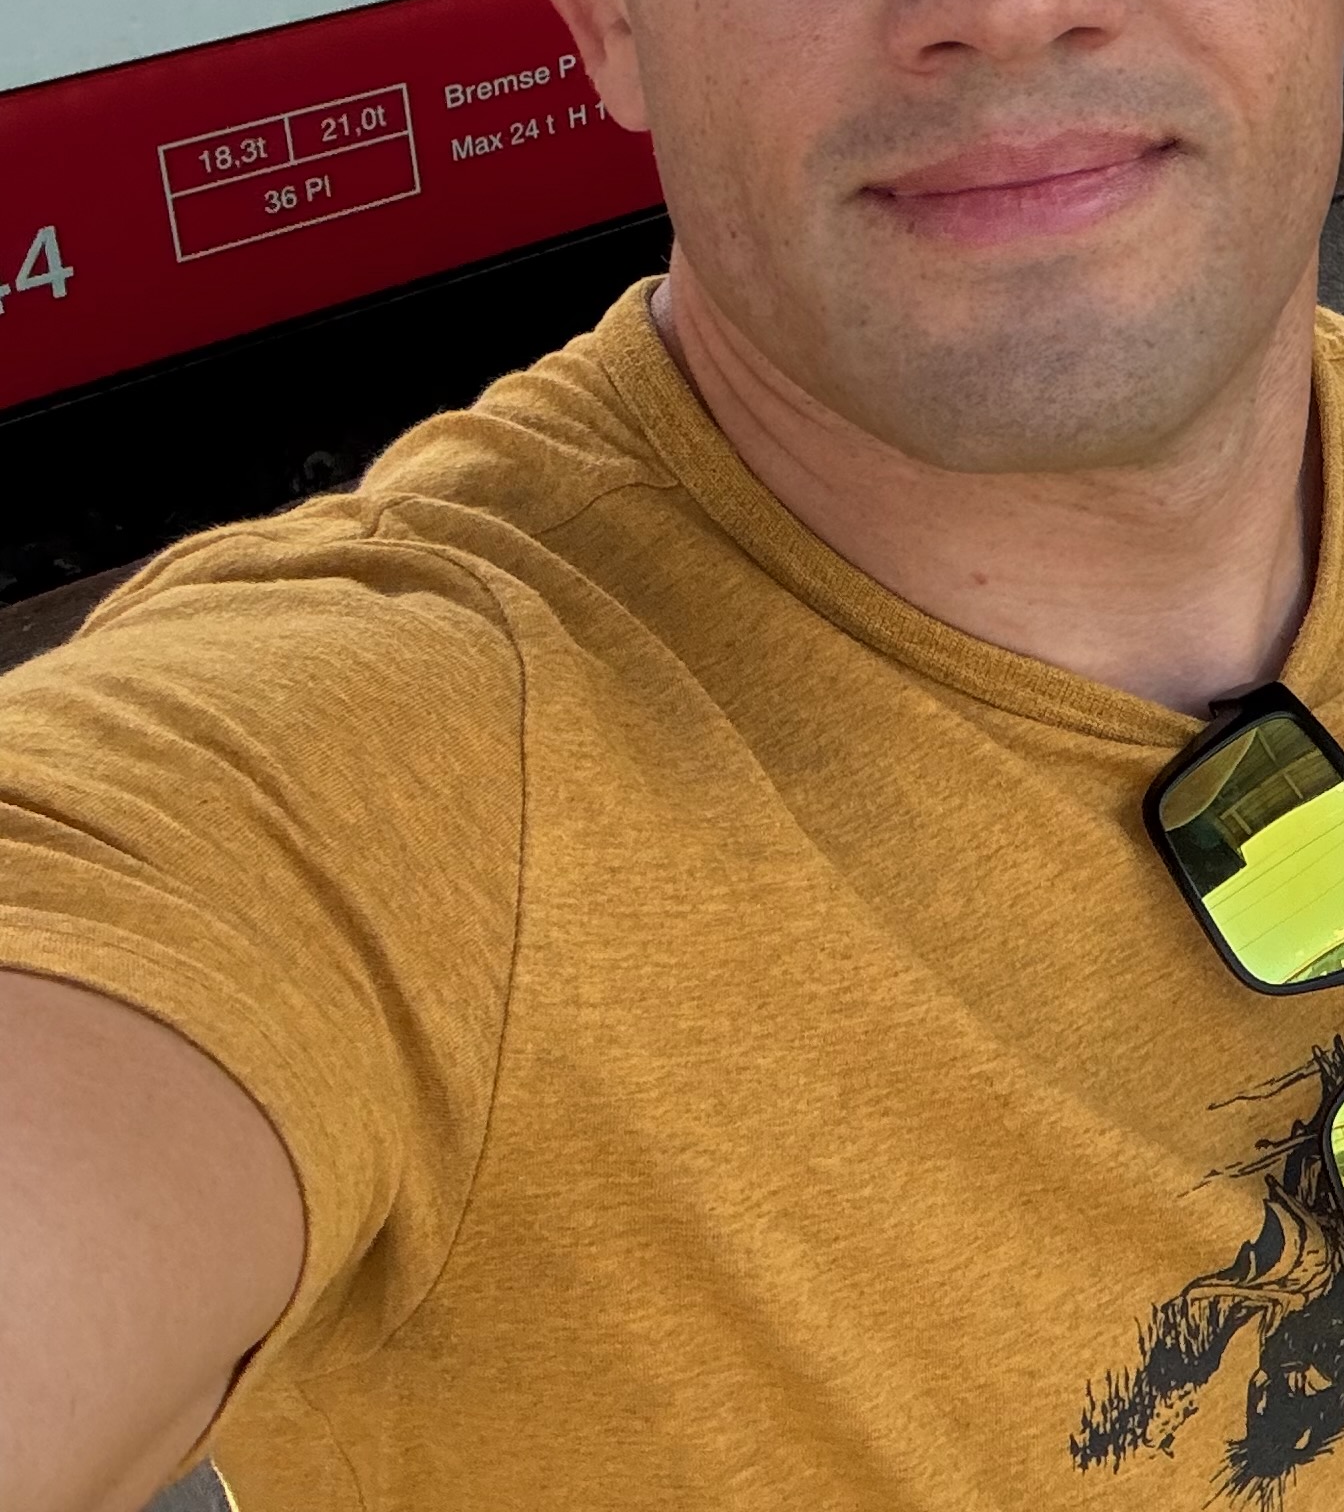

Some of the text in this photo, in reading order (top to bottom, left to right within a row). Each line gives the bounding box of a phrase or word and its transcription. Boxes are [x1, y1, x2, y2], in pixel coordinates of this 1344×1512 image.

[444, 53, 577, 109] Bremse P
[198, 104, 387, 174] 18,3t 21,0t
[450, 131, 504, 162] Max
[509, 118, 540, 146] 24
[567, 103, 588, 129] H
[264, 185, 298, 215] 36
[0, 224, 75, 316] 4
